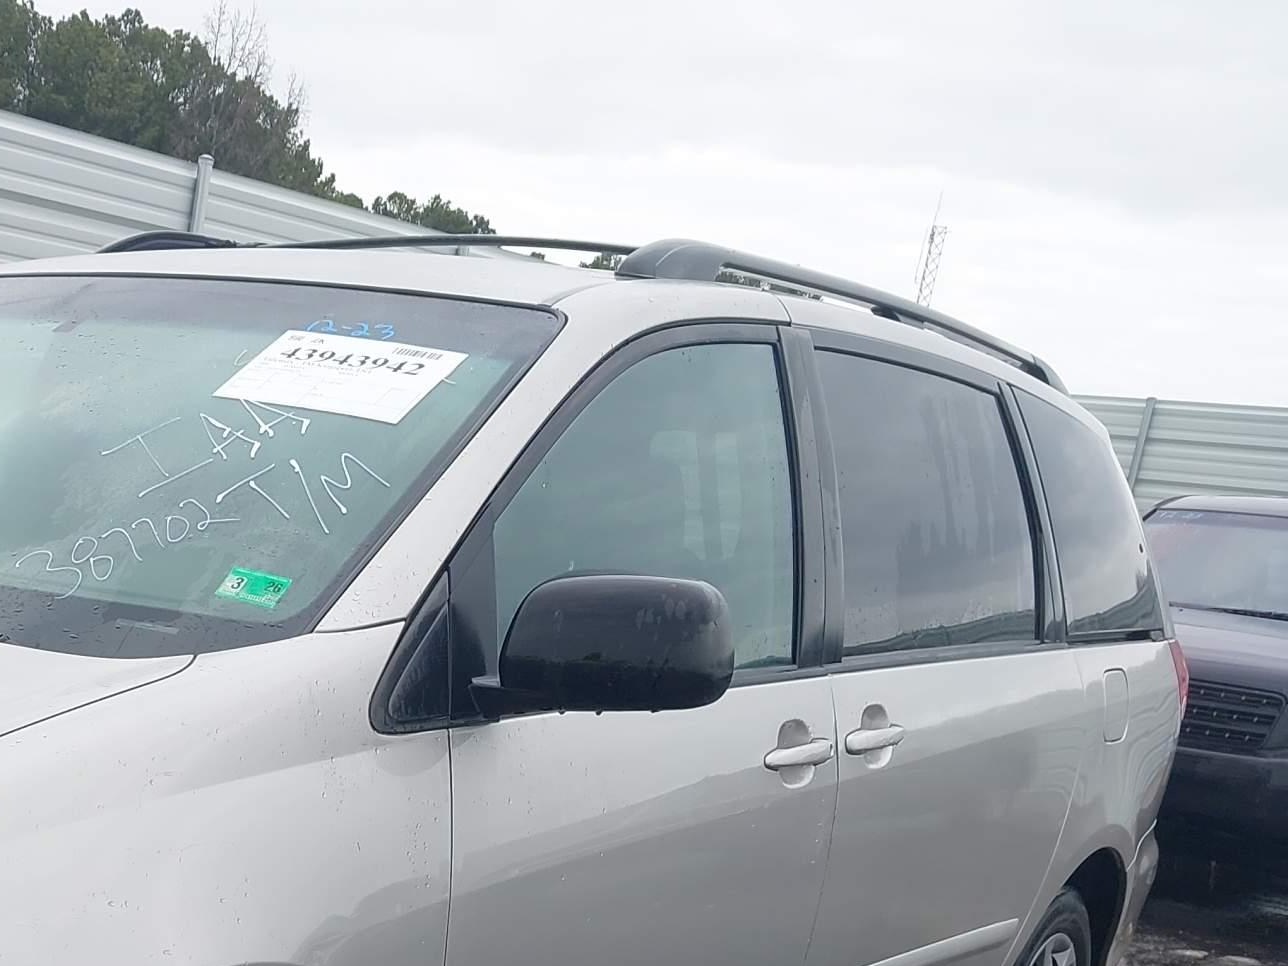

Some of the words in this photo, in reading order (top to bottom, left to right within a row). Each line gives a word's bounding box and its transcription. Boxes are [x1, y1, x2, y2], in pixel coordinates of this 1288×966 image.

[280, 346, 427, 376] 43943942
[230, 577, 245, 590] 3
[264, 581, 284, 594] 26
